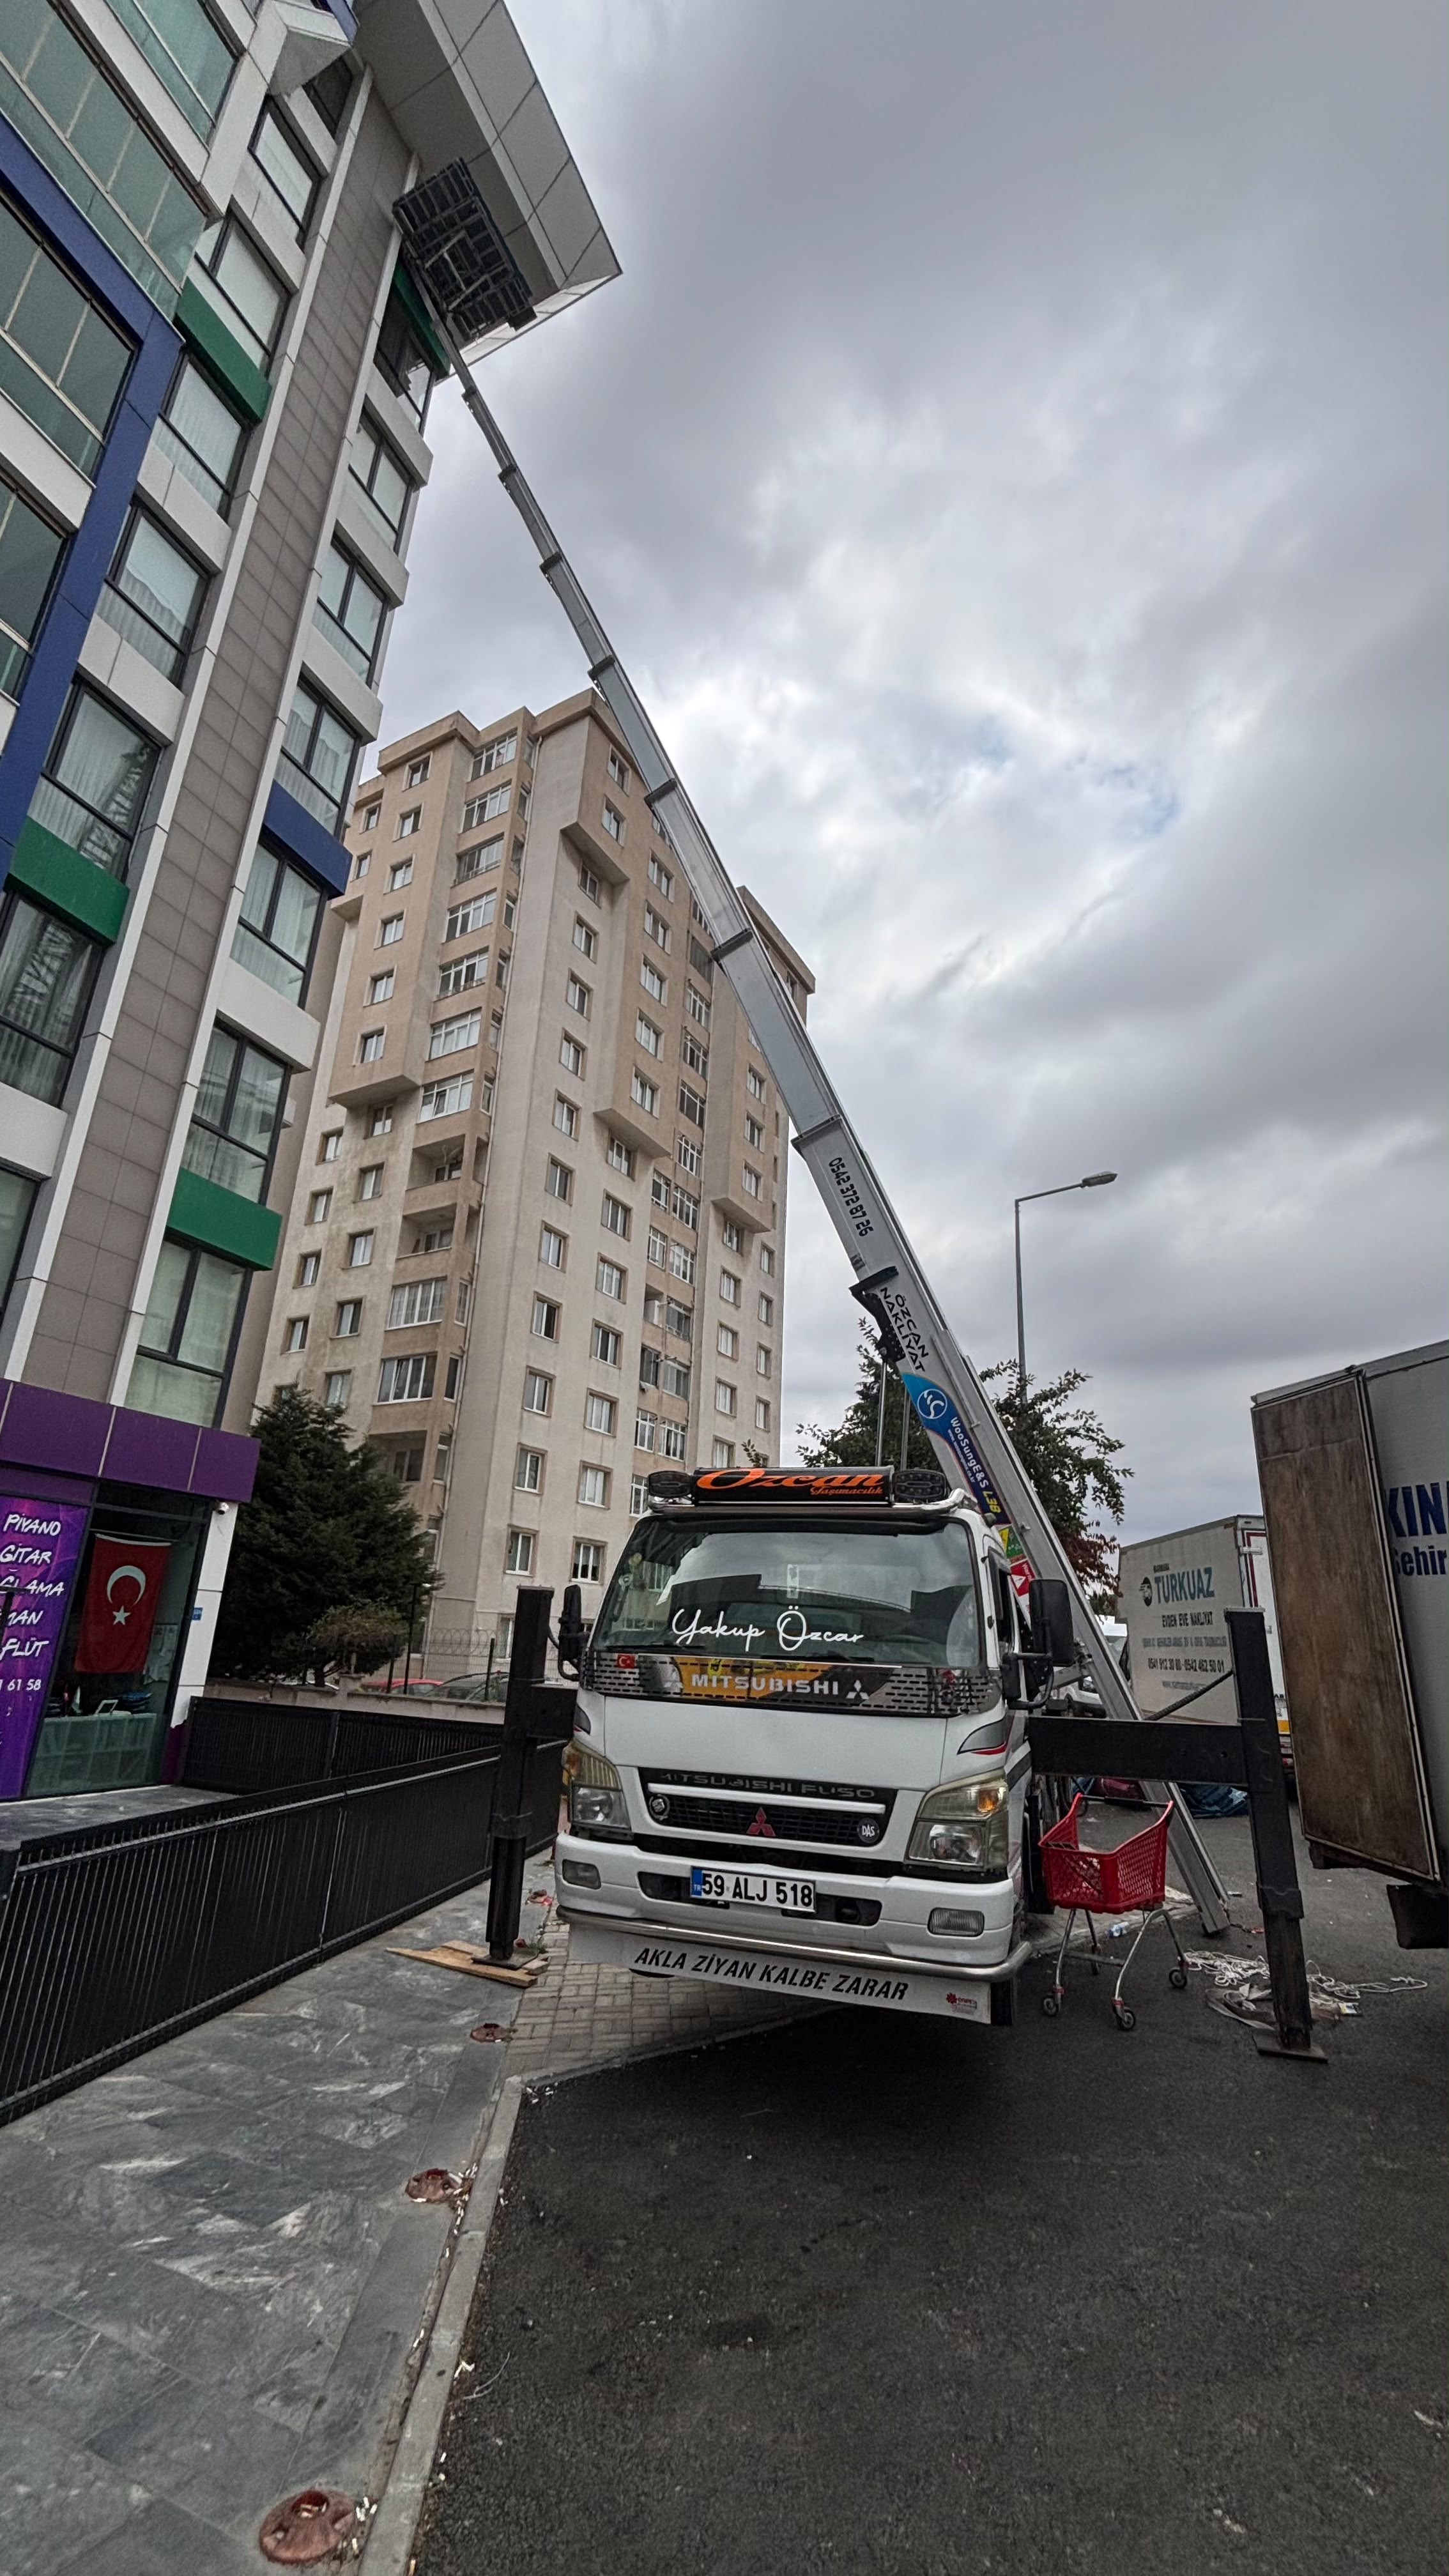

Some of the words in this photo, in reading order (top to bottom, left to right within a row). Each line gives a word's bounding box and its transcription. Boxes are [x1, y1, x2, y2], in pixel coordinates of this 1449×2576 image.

[829, 1157, 851, 1186] 0542
[840, 1183, 860, 1206] 372
[849, 1204, 867, 1219] 87
[855, 1219, 875, 1237] 26
[880, 1286, 925, 1372] NAKLİYAT
[895, 1293, 929, 1358] ÖZCAN
[950, 1416, 989, 1488] WooSungE&S
[1388, 1481, 1449, 1538] KIN
[3, 1513, 61, 1536] PİYANO
[0, 1543, 52, 1565] GİTAR
[1154, 1567, 1215, 1604] TURKUAZ
[672, 1608, 765, 1652] Yakup
[0, 1637, 50, 1660] FLÜT
[7, 1679, 22, 1691] 61
[26, 1679, 42, 1691] 58
[692, 1673, 838, 1695] MITSUBISHI
[801, 1783, 875, 1798] FUSO
[703, 1873, 724, 1896] 59
[732, 1876, 767, 1902] ALJ
[776, 1881, 813, 1907] 518
[634, 1947, 687, 1970] AKLA
[691, 1952, 756, 1980] ZİYAN
[758, 1963, 831, 1991] KALBE
[831, 1974, 909, 2000] ZARAR
